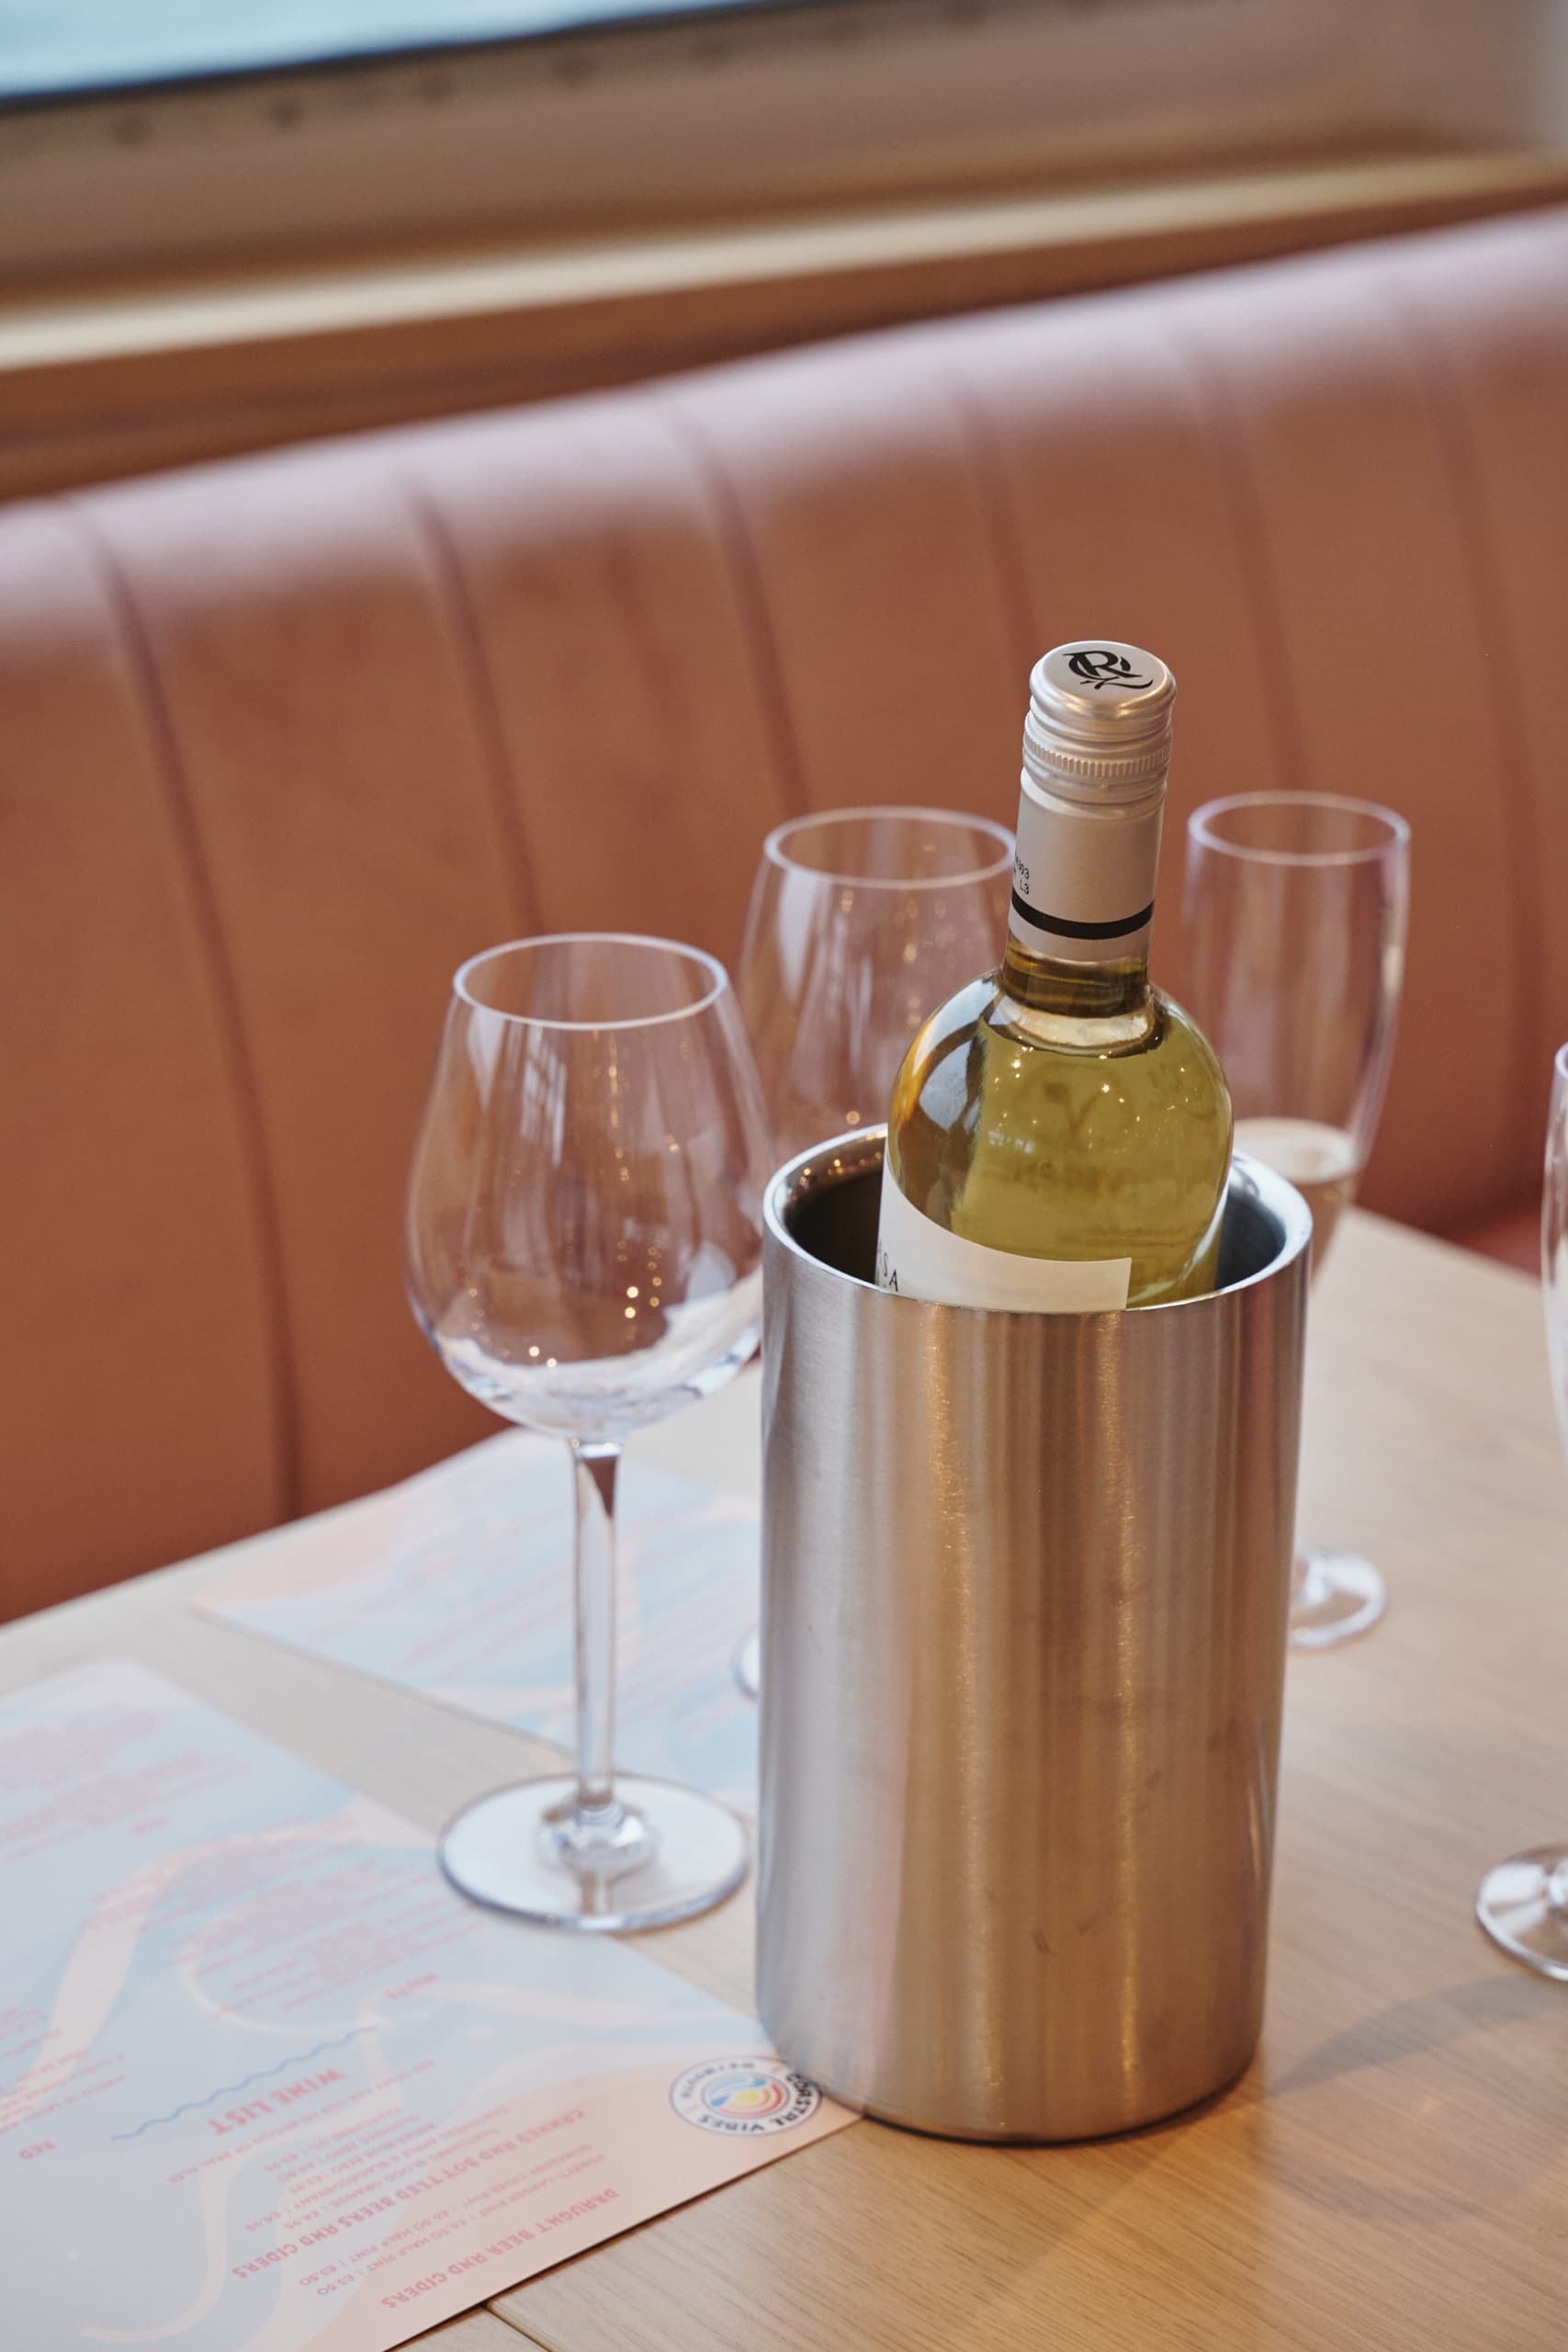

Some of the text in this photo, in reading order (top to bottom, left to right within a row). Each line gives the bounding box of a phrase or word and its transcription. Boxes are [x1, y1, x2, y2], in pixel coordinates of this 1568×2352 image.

[208, 2068, 346, 2134] WINE LIST
[697, 2073, 812, 2132] COASTAL VIBES
[17, 2139, 56, 2160] RED
[477, 2139, 517, 2161] AND
[394, 2156, 480, 2200] BOTTLED
[336, 2196, 397, 2227] BEERS
[297, 2223, 340, 2246] AND
[231, 2242, 299, 2278] CIDERS
[348, 2245, 378, 2260] PINT
[378, 2188, 619, 2309] DRAUGHT BEER AND CIDERS
[366, 2255, 397, 2270] PINT
[315, 2274, 355, 2295] £3.50
